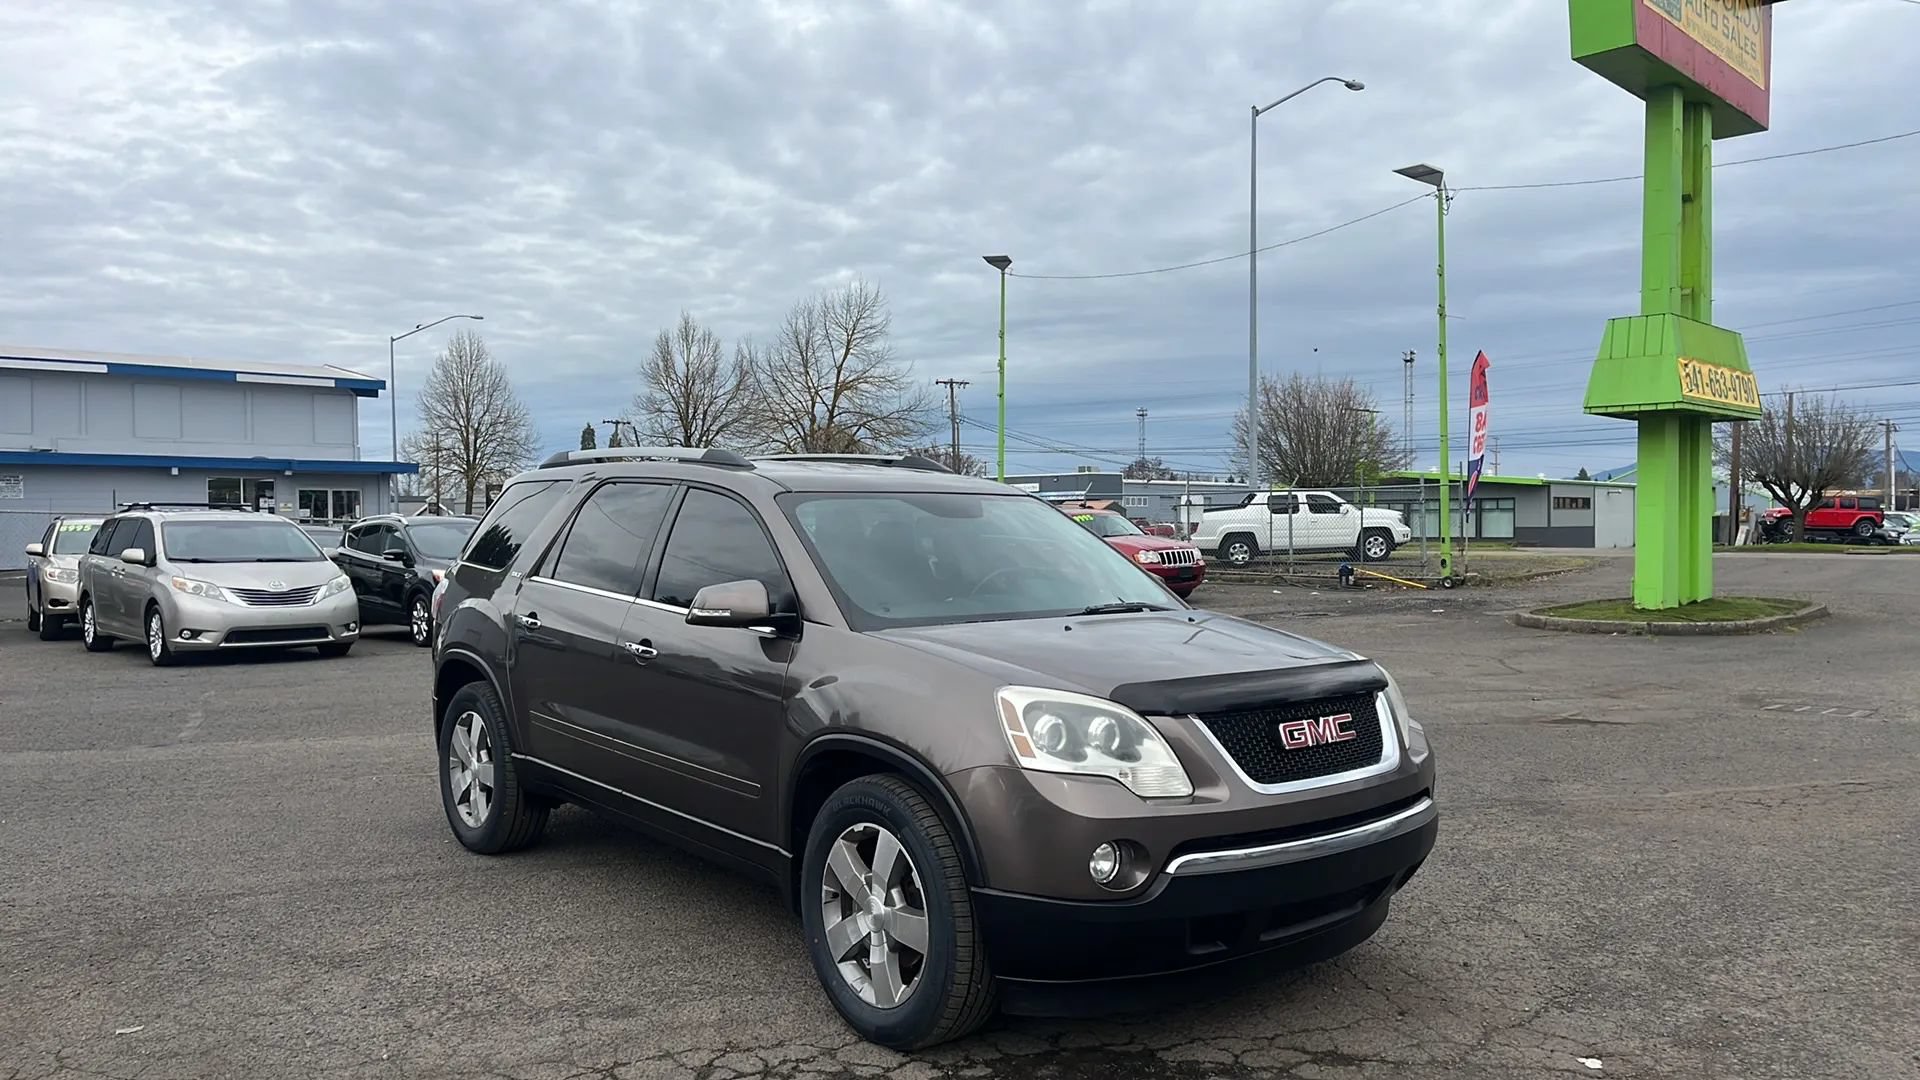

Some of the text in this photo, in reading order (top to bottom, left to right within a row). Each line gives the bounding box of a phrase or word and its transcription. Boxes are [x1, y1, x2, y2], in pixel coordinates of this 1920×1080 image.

[1685, 0, 1718, 30] AUTO
[1722, 14, 1757, 60] SALES
[1279, 713, 1356, 750] GMC
